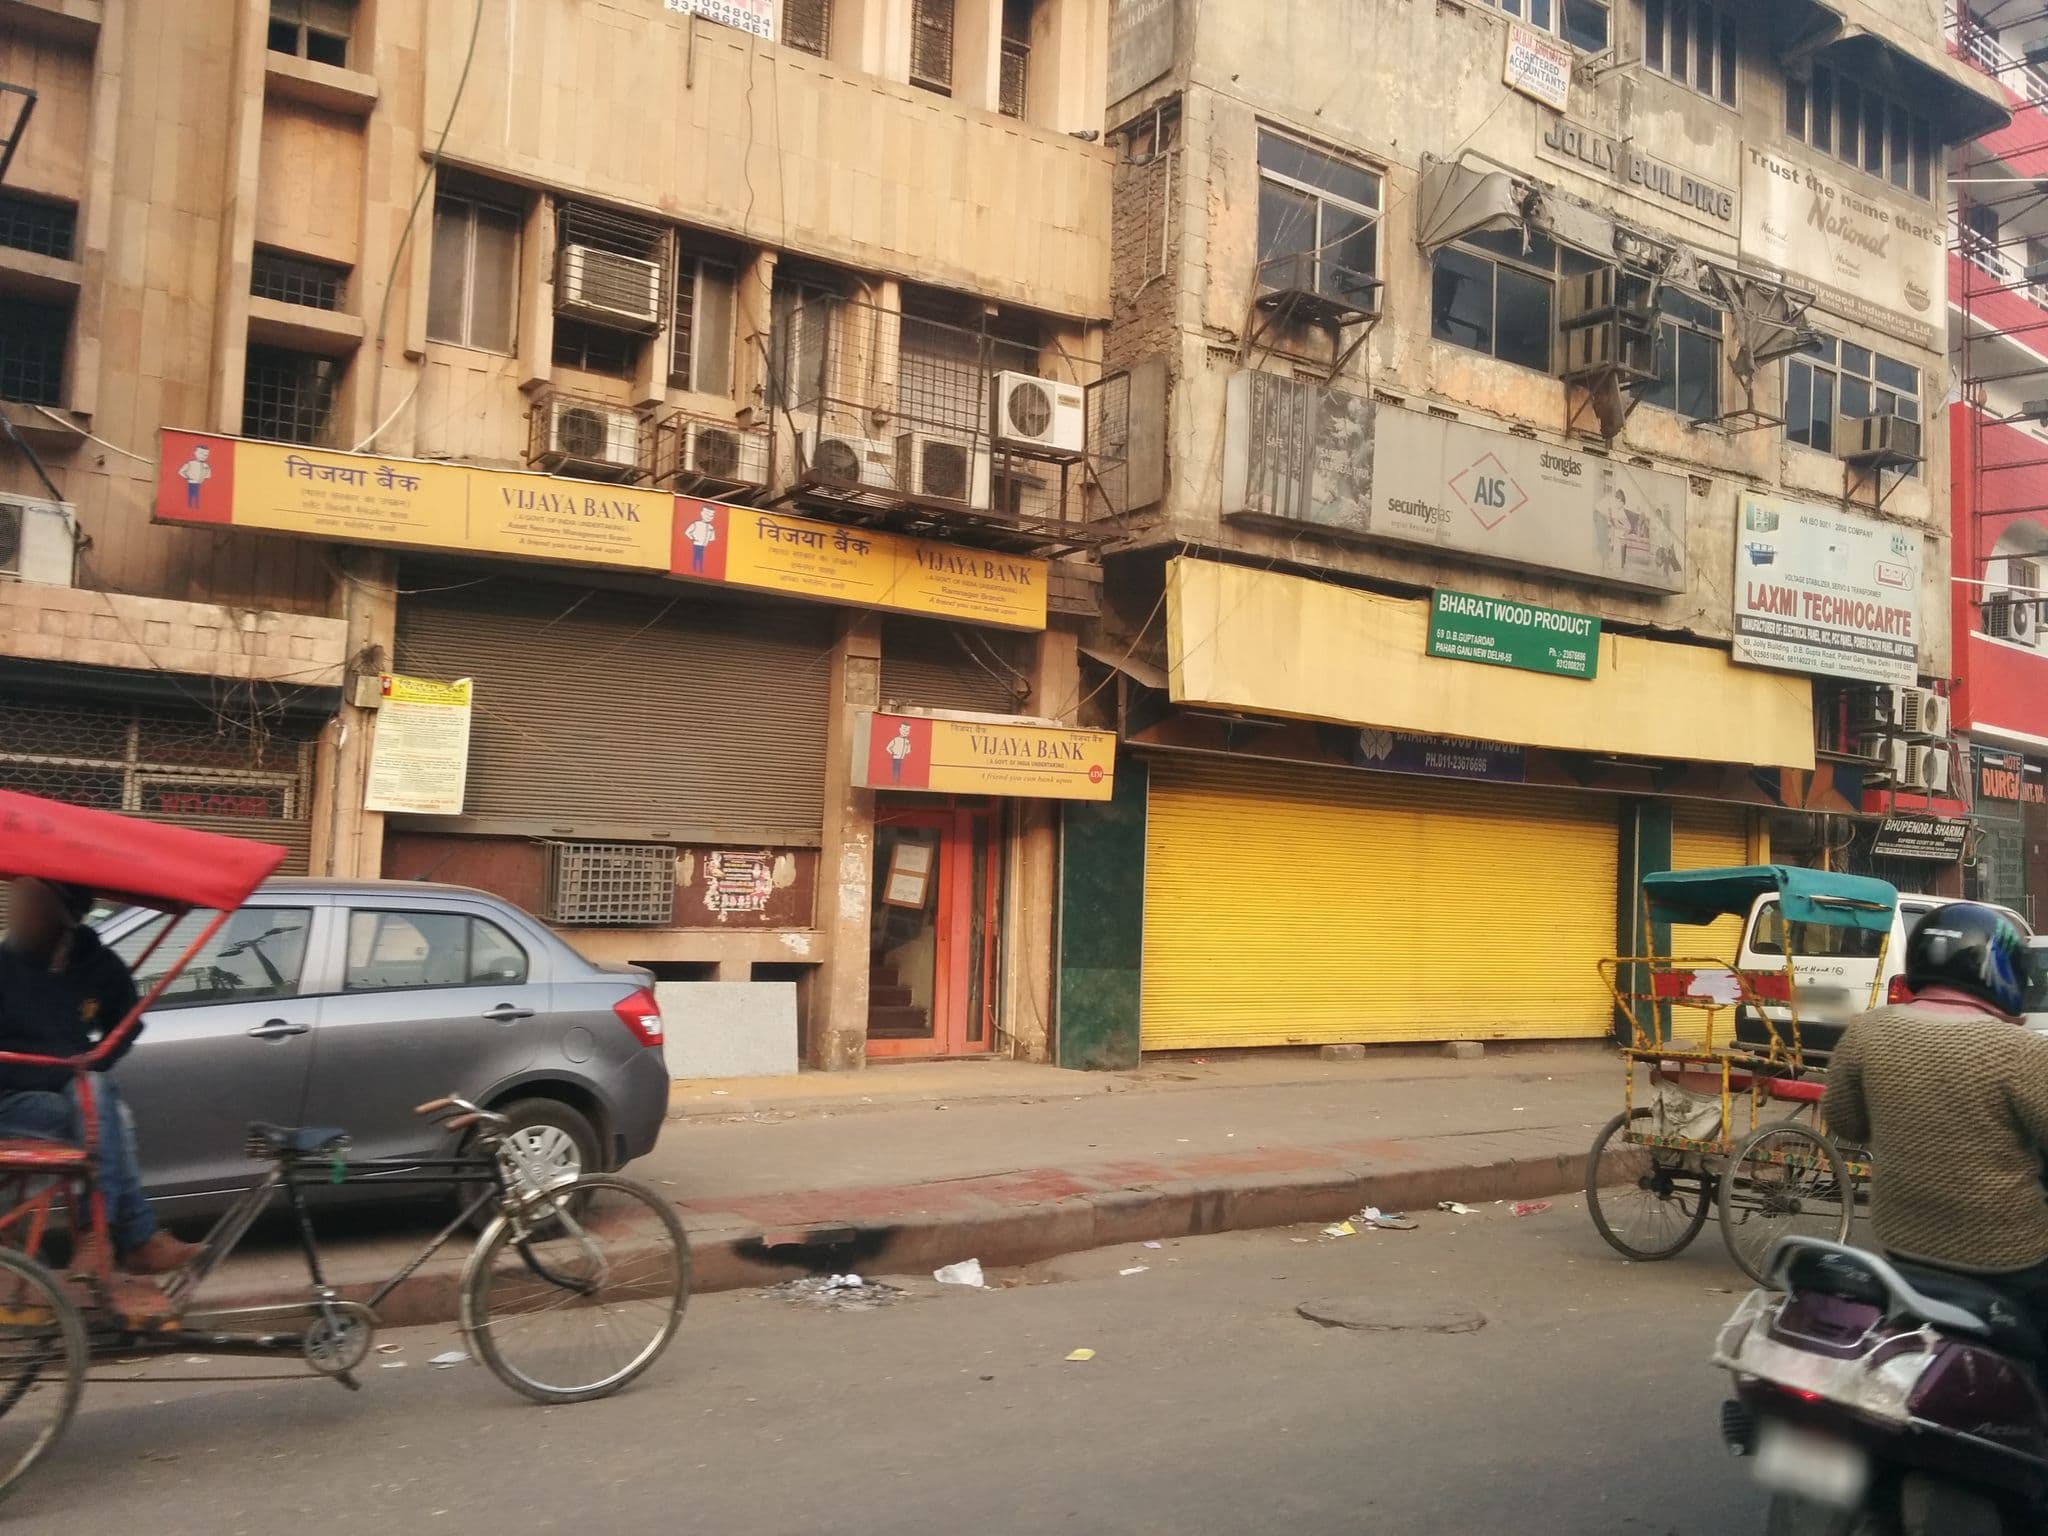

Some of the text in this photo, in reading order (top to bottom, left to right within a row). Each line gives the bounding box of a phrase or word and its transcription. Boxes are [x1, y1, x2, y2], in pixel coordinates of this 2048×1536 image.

[1509, 54, 1566, 92] ACCOUNTANTS
[1515, 46, 1559, 76] CHARTERED
[1544, 119, 1732, 221] JOLLY BUILDING
[1749, 149, 1942, 246] Trust the name that's
[1806, 197, 1890, 259] National
[1808, 281, 1855, 308] Plywood
[1858, 301, 1911, 330] Industries
[1913, 321, 1933, 337] Ltd.
[284, 454, 421, 492] विजया बैंक
[1474, 476, 1506, 508] AIS
[501, 487, 641, 523] VIJAYA BANK
[755, 516, 872, 557] विजया बैंक
[915, 549, 1032, 586] VIJAYA BANK
[1439, 593, 1592, 637] BHARAT WOOD PRODUCT
[1747, 580, 1912, 638] LAXMI TECHNOCARTE
[1435, 641, 1456, 654] PAHAR
[1457, 645, 1472, 657] GANJ
[1472, 647, 1487, 658] NEW
[1436, 628, 1445, 638] 69
[970, 735, 1085, 761] VIJAYA BANK
[1884, 819, 1966, 838] BHUPENDRA SHARMA
